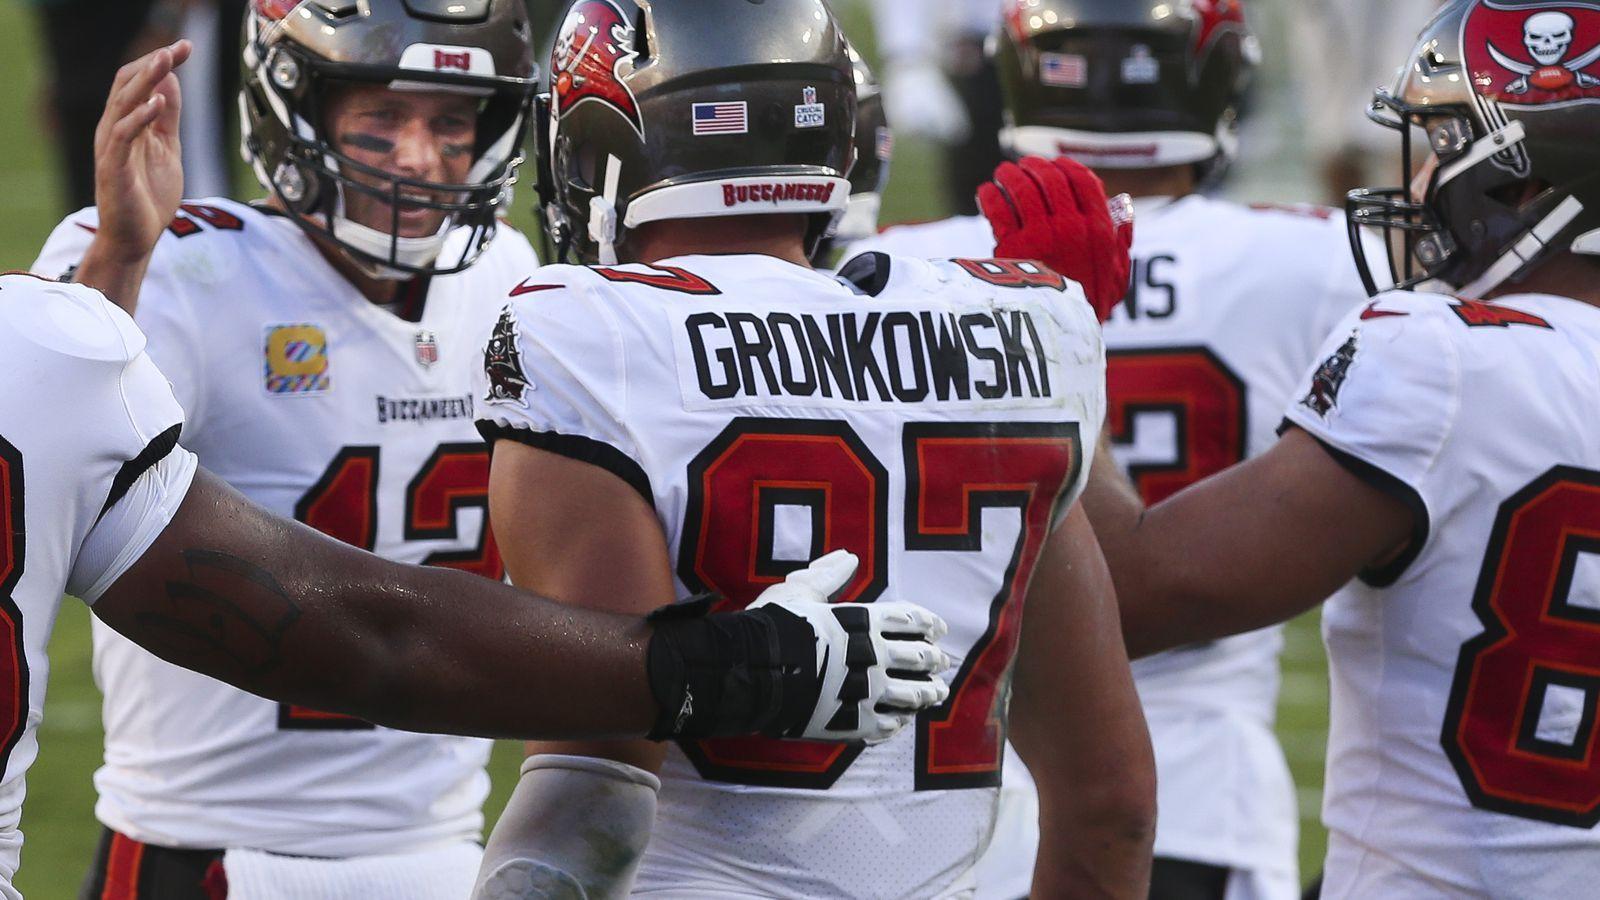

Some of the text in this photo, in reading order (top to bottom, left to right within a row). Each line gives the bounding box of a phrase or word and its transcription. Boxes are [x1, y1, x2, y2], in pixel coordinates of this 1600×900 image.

[722, 182, 835, 207] BUCCANEERS
[685, 311, 1051, 402] GRONKOWSKI
[677, 416, 1082, 791] 87
[1440, 464, 1600, 829] 8
